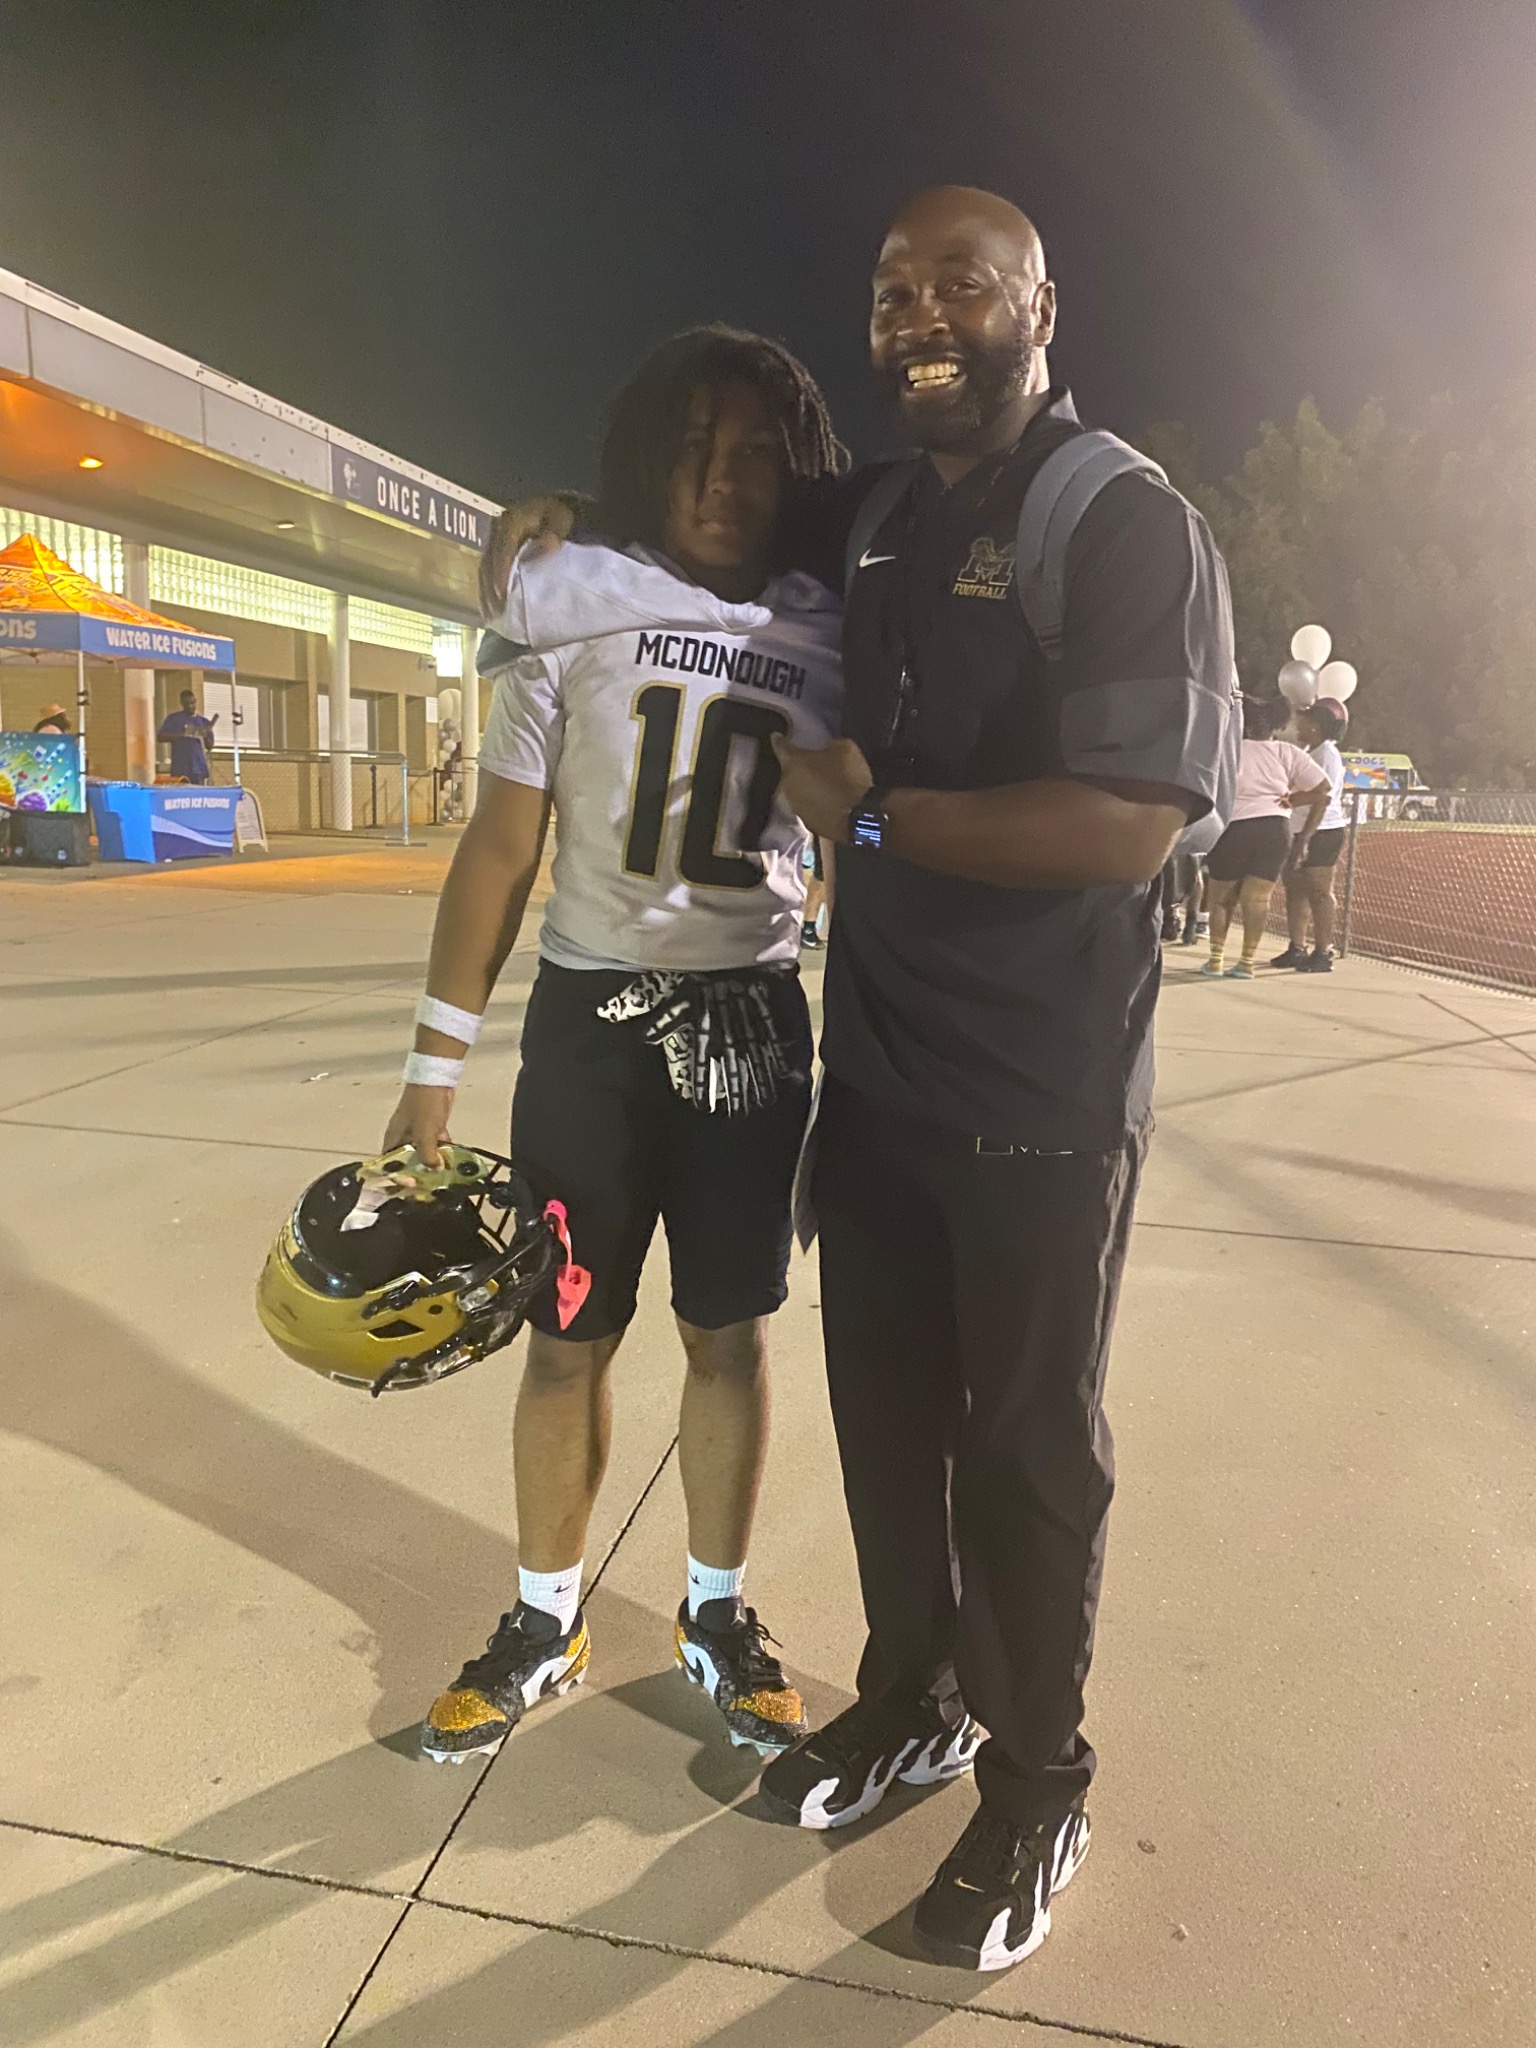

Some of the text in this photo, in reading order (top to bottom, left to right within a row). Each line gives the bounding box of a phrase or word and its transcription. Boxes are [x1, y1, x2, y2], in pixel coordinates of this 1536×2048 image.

[376, 476, 421, 521] ONCE
[428, 497, 438, 527] A
[952, 583, 1007, 600] FOOTBALL
[635, 632, 806, 700] MCDONOUGH
[621, 680, 793, 893] 10
